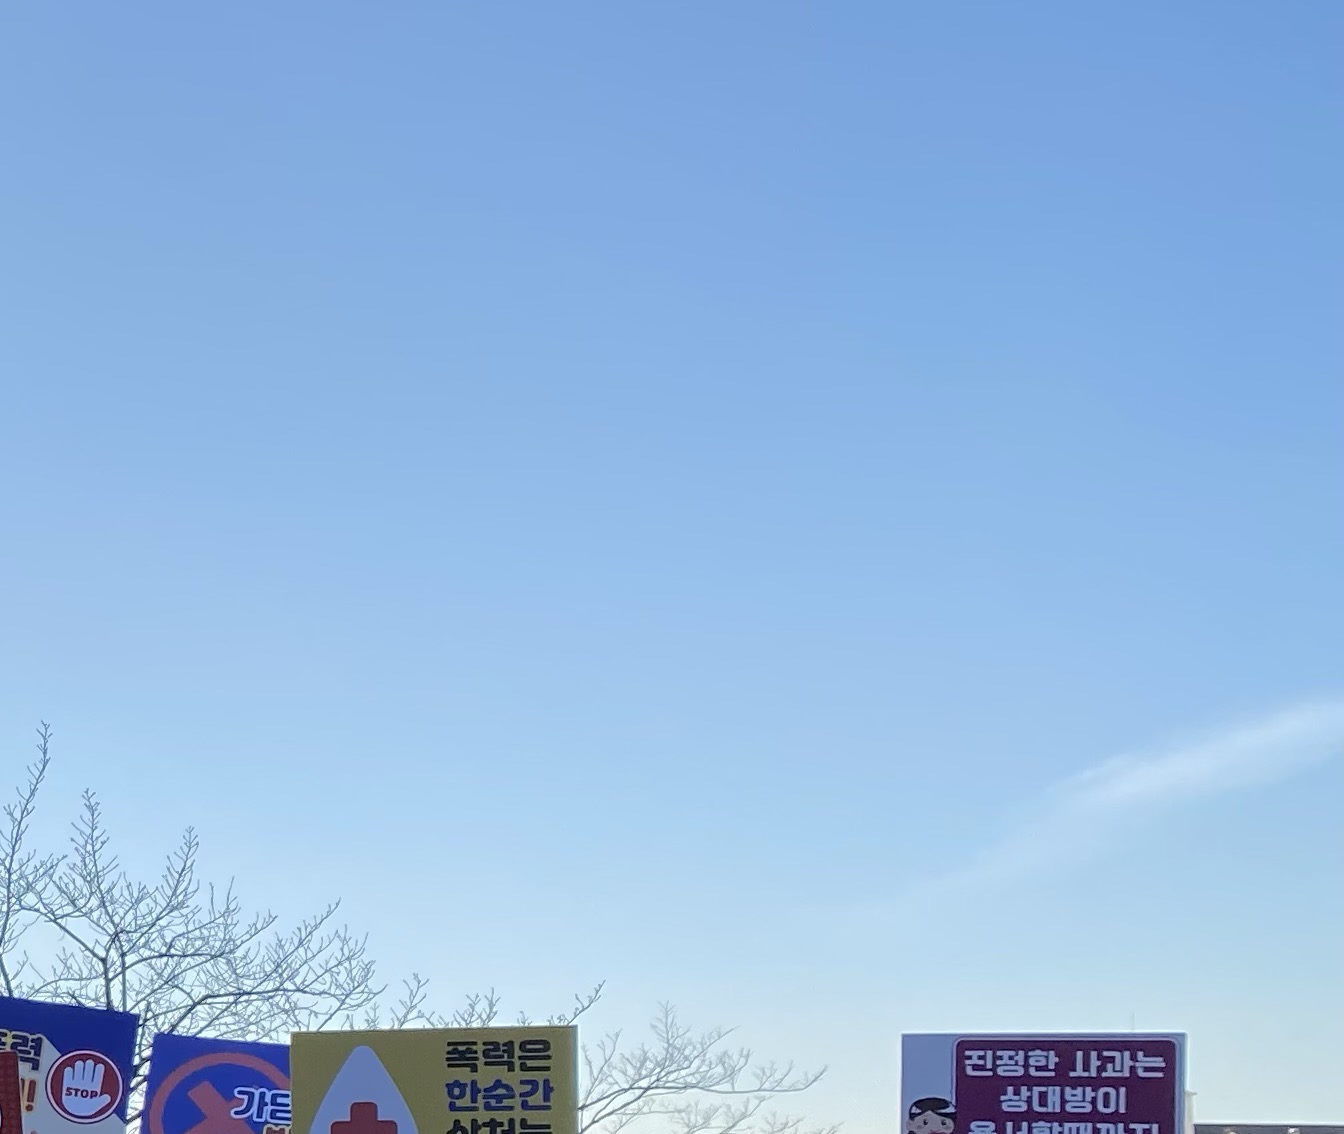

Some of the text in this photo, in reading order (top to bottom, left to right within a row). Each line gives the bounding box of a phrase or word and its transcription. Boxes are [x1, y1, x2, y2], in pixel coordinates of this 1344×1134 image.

[445, 1038, 553, 1074] 폭력은
[964, 1048, 1166, 1079] 진정한 사과는
[65, 1087, 99, 1099] STOP
[445, 1078, 554, 1112] 한순간
[999, 1085, 1127, 1114] 상대방이
